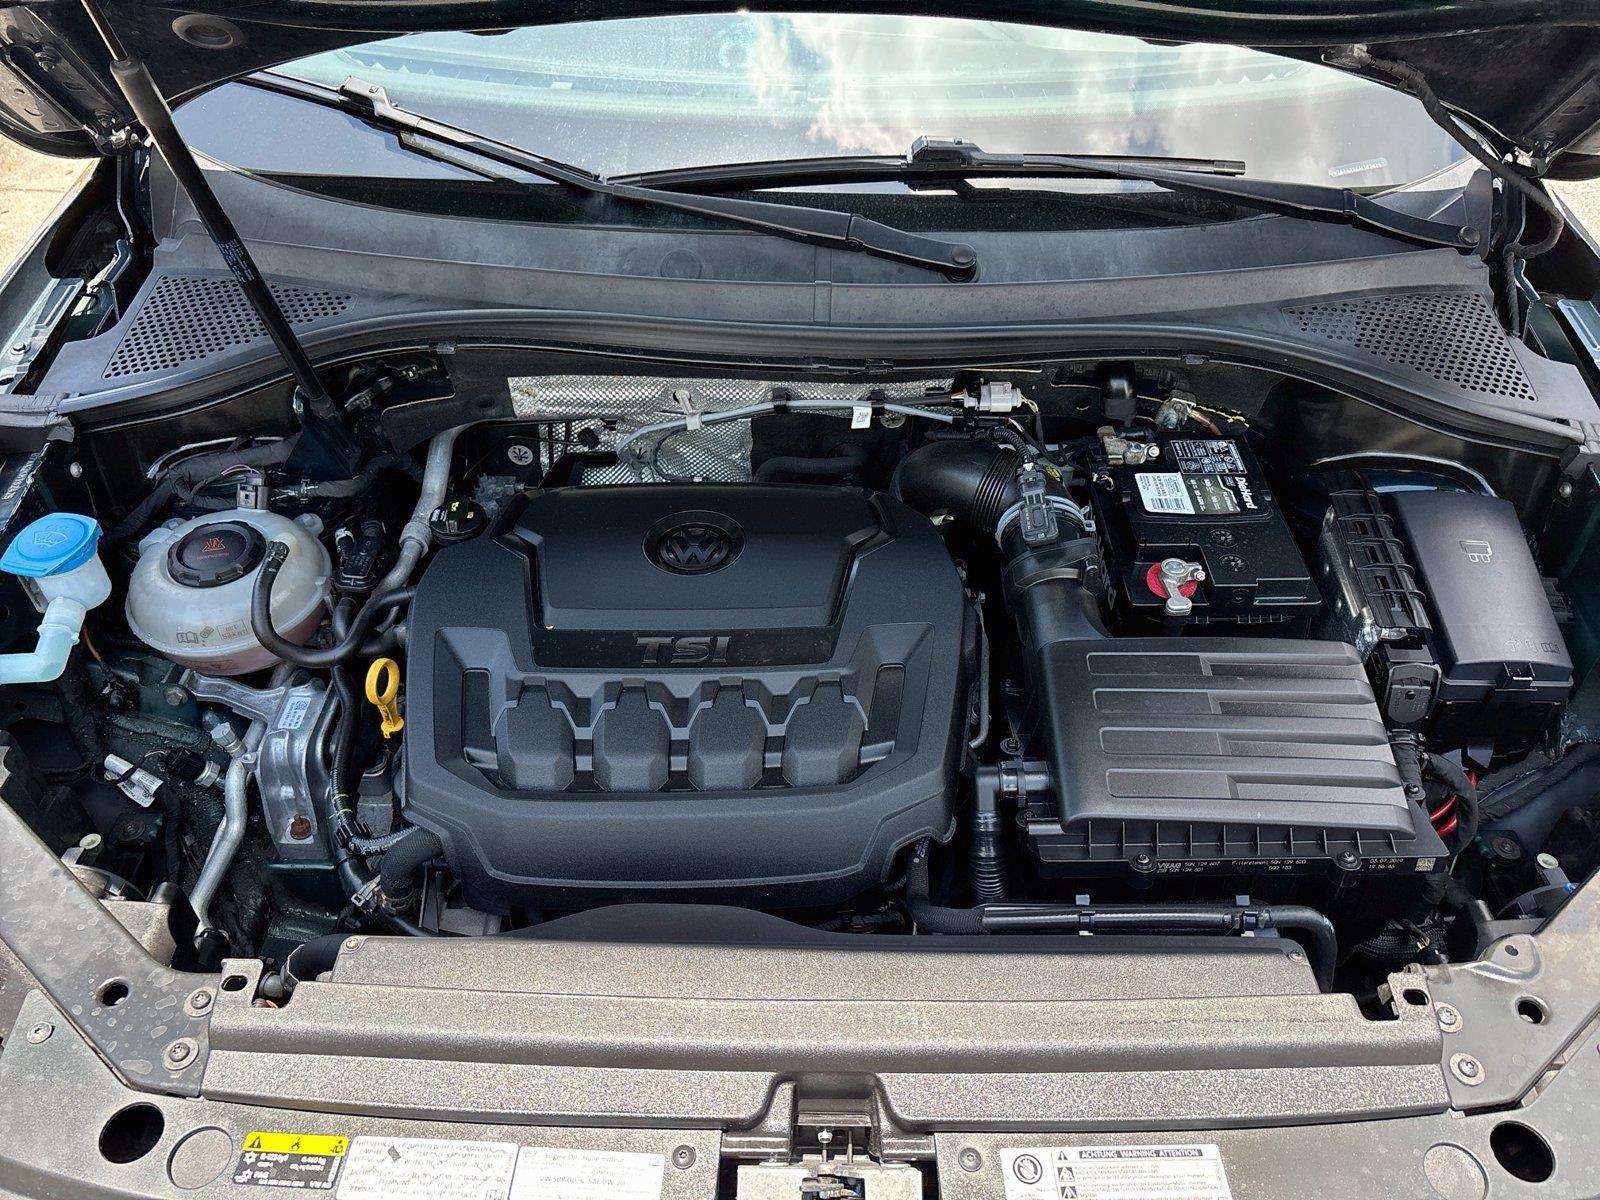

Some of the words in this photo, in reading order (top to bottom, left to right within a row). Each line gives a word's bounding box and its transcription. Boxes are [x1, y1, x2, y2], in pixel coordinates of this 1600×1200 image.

[1235, 476, 1258, 509] DieHard
[635, 636, 732, 664] TSI
[1081, 1150, 1118, 1159] ACHTUNG
[1120, 1149, 1156, 1158] WARNING
[1159, 1148, 1199, 1157] ATTENTION
